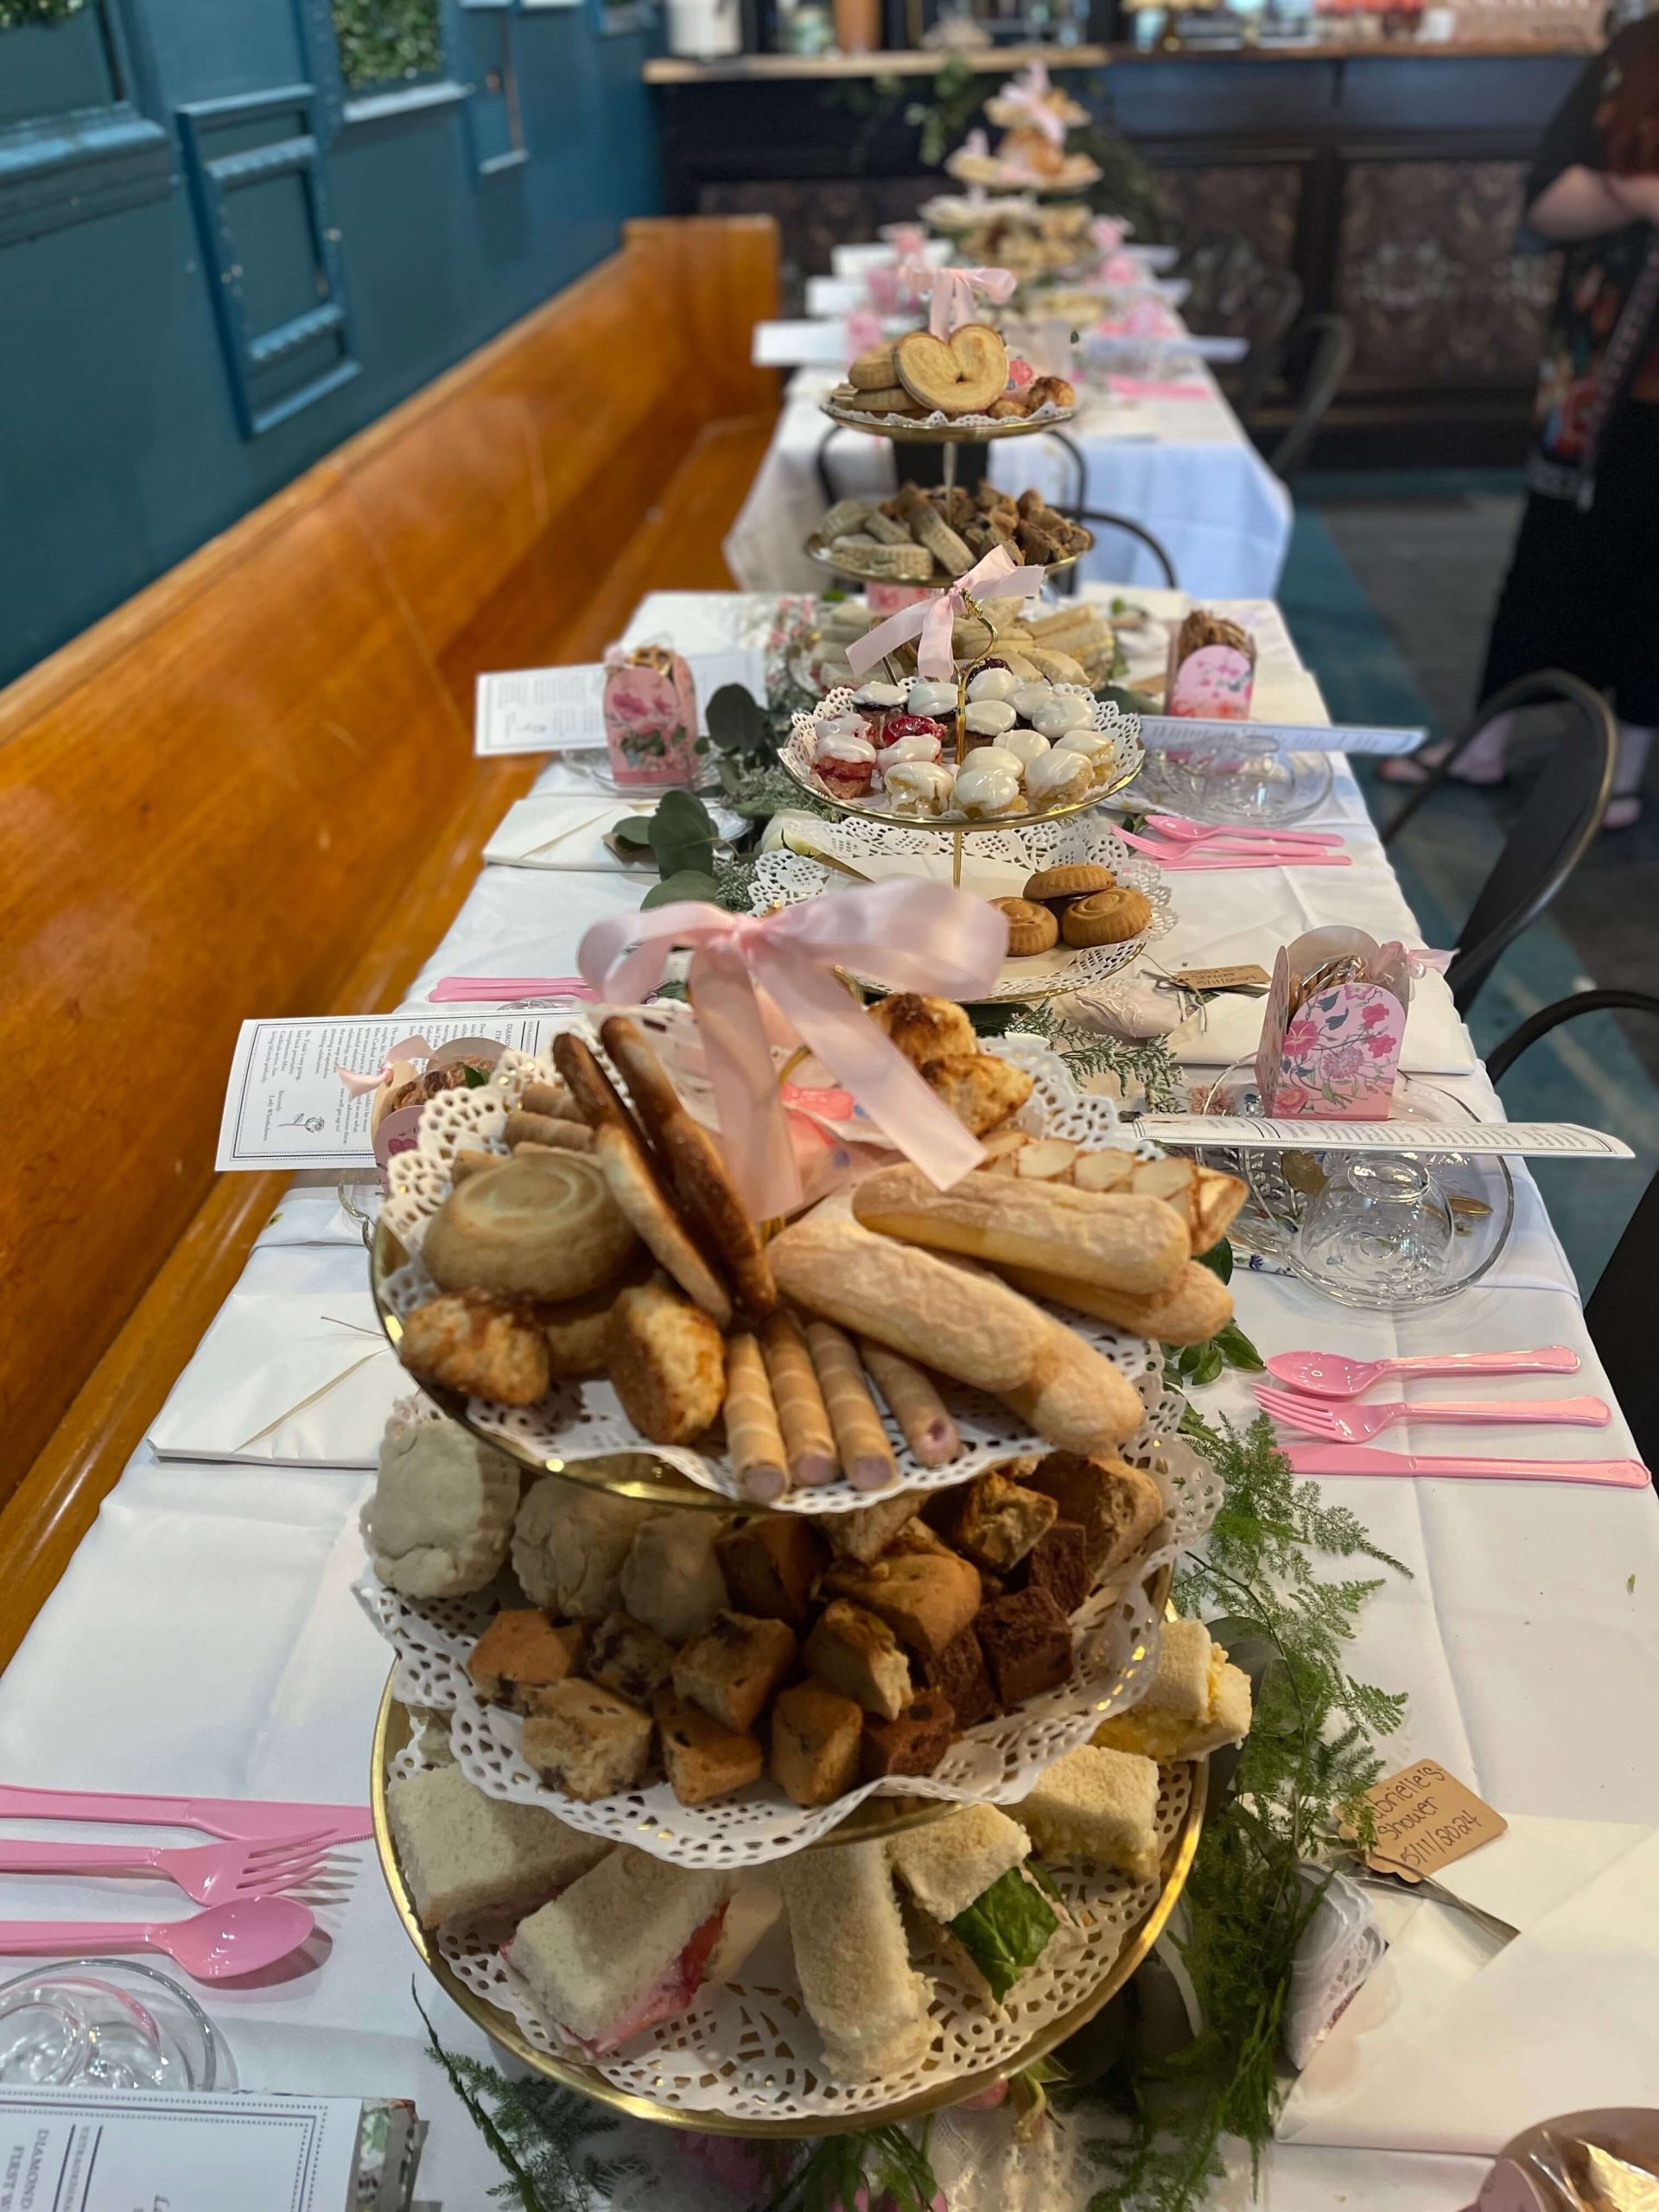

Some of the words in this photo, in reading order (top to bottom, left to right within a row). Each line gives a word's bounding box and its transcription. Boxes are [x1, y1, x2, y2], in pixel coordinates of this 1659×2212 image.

[1364, 1766, 1446, 1820] abrielle's
[1376, 1796, 1439, 1841] Shower
[1400, 1809, 1482, 1867] 5/11/2024
[2, 2145, 25, 2190] FIRST
[21, 2129, 50, 2209] DIAMOND
